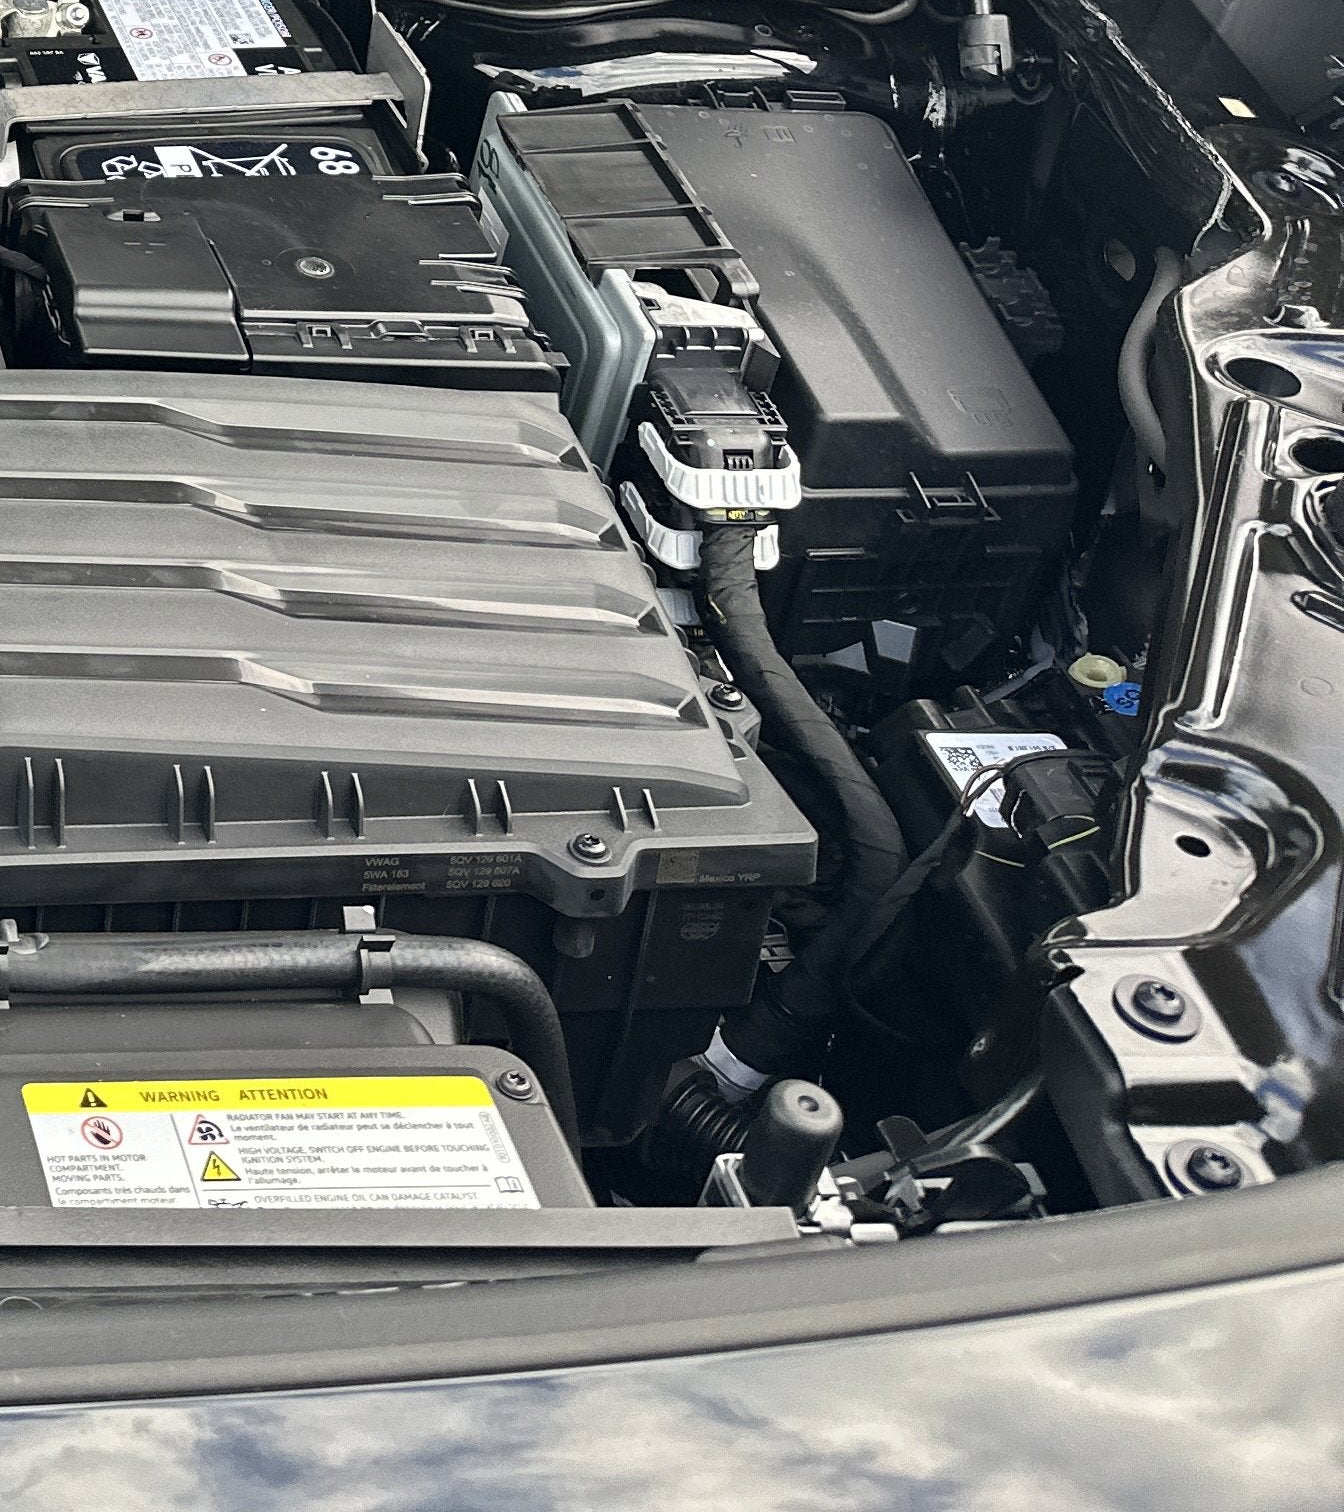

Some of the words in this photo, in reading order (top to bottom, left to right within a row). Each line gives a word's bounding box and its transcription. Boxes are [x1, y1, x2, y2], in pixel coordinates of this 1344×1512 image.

[139, 1090, 220, 1103] WARNING
[239, 1088, 328, 1101] ATTENTION
[226, 1113, 273, 1121] RADIATOR
[275, 1113, 294, 1121] FAN
[317, 1112, 345, 1120] START
[244, 1124, 295, 1132] ventilateur
[311, 1123, 353, 1131] radiateur
[357, 1123, 378, 1132] peut
[238, 1147, 262, 1155] HIGH
[309, 1146, 345, 1154] SWITCH
[367, 1145, 401, 1153] ENGINE
[404, 1144, 440, 1152] BEFORE
[442, 1144, 490, 1152] TOUCHING
[47, 1155, 66, 1163] HOT
[68, 1155, 98, 1163] PARTS
[112, 1154, 147, 1162] MOTOR
[52, 1175, 91, 1183] MOVING
[55, 1187, 113, 1197] Composants
[114, 1187, 132, 1195] très
[135, 1186, 166, 1194] chauds
[168, 1186, 191, 1194] dans
[254, 1195, 312, 1203] OVERFILLED
[314, 1194, 349, 1202] ENGINE
[369, 1193, 390, 1201] CAN
